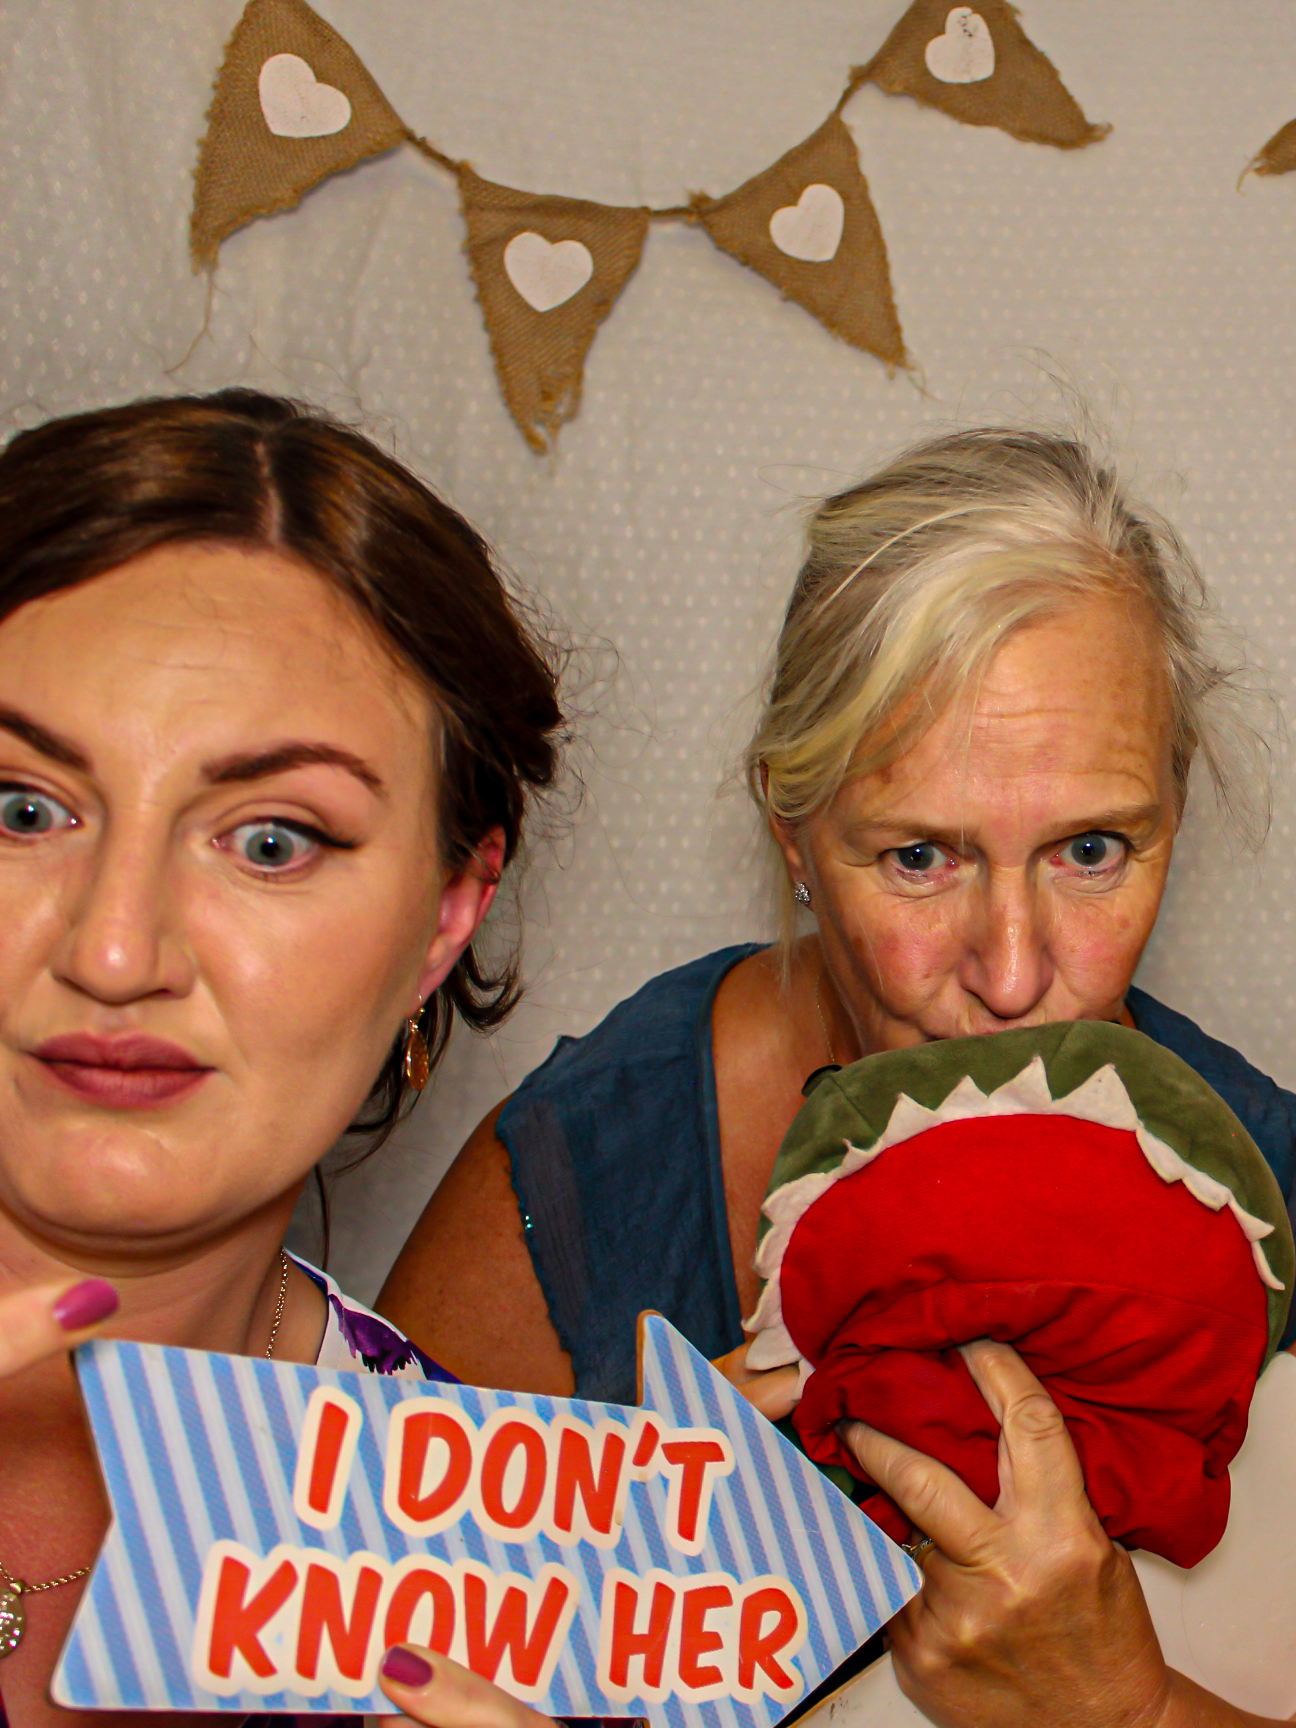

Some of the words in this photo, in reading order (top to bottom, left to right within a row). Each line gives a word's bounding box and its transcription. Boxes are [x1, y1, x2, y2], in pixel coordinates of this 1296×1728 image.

[308, 1401, 350, 1514] I
[397, 1411, 726, 1543] DON'T
[207, 1556, 571, 1688] KNOW
[608, 1580, 801, 1691] HER
